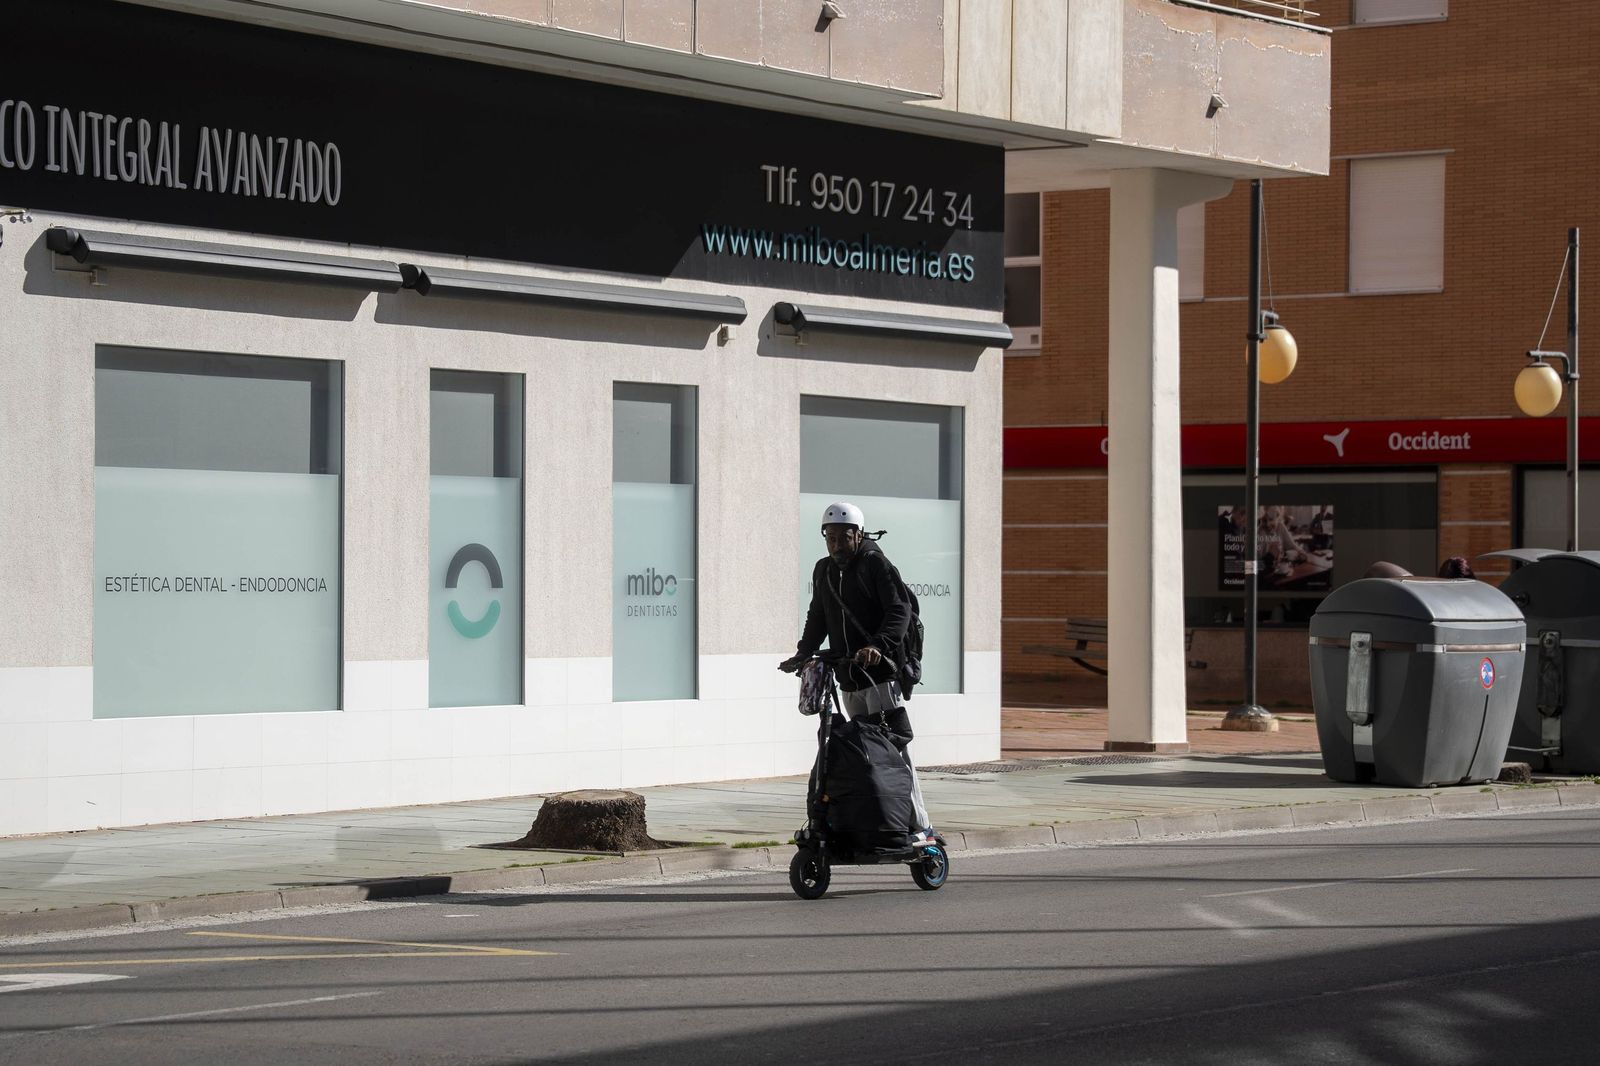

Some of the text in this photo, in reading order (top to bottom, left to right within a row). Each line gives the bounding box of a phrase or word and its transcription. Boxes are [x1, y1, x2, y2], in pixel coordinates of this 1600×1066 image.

[42, 104, 188, 190] INTEGRAL
[193, 126, 342, 207] AVANZADO
[760, 164, 975, 229] Tlf. 950 17 24 34
[703, 223, 975, 282] www.miboalmeria.es
[1388, 431, 1472, 450] Occident
[105, 572, 171, 593] ESTÉTICA
[175, 576, 227, 592] DENTAL
[239, 577, 328, 593] ENDODONCIA
[627, 567, 678, 596] mibo
[906, 583, 951, 597] ODONCIA
[627, 605, 678, 617] DENTISTAS
